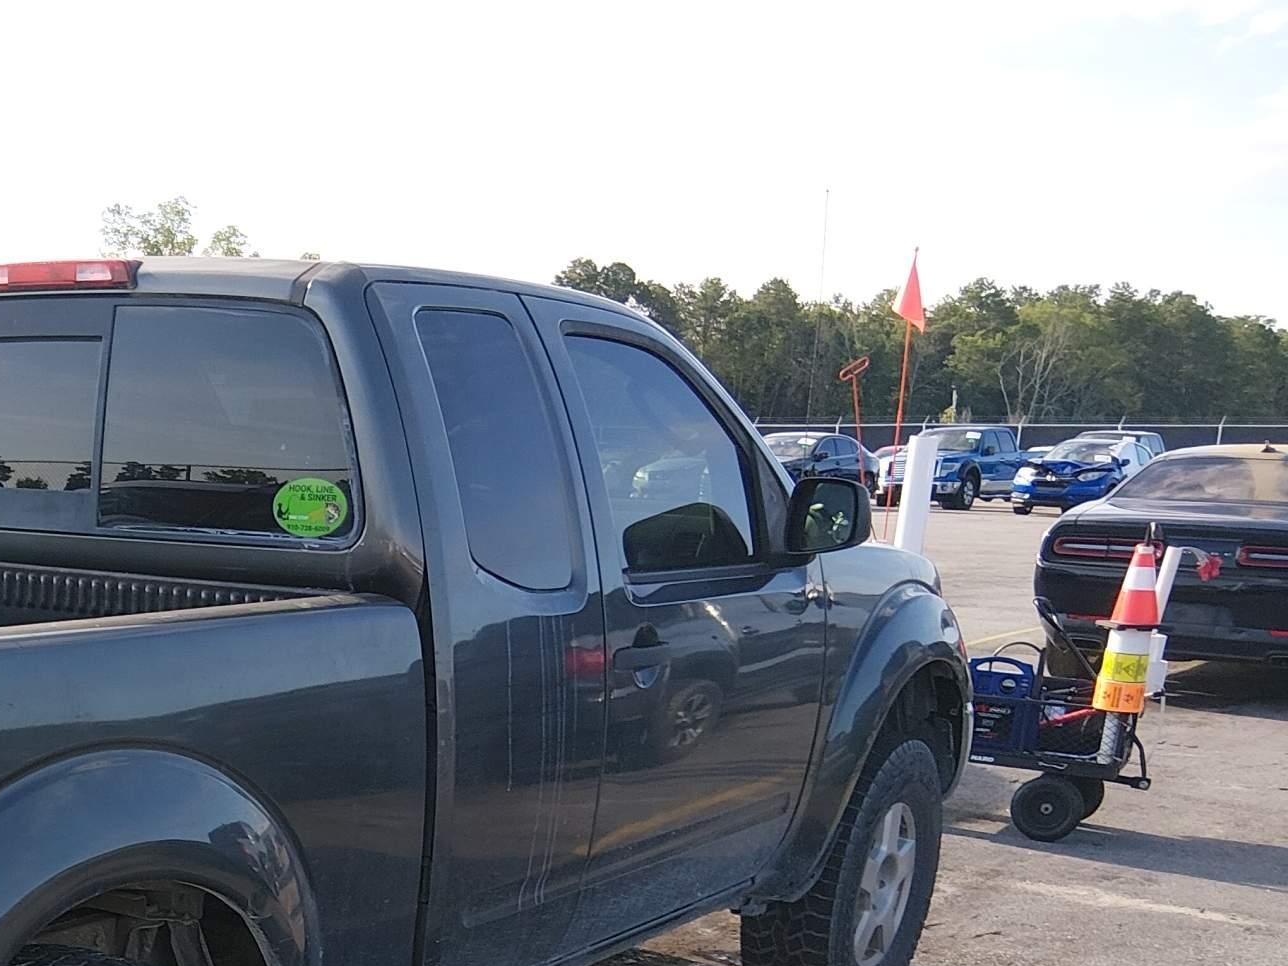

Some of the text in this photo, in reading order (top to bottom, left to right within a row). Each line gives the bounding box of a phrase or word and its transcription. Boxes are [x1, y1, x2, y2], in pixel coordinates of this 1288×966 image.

[289, 484, 336, 493] HOOK, LINE
[307, 493, 337, 502] SINKER
